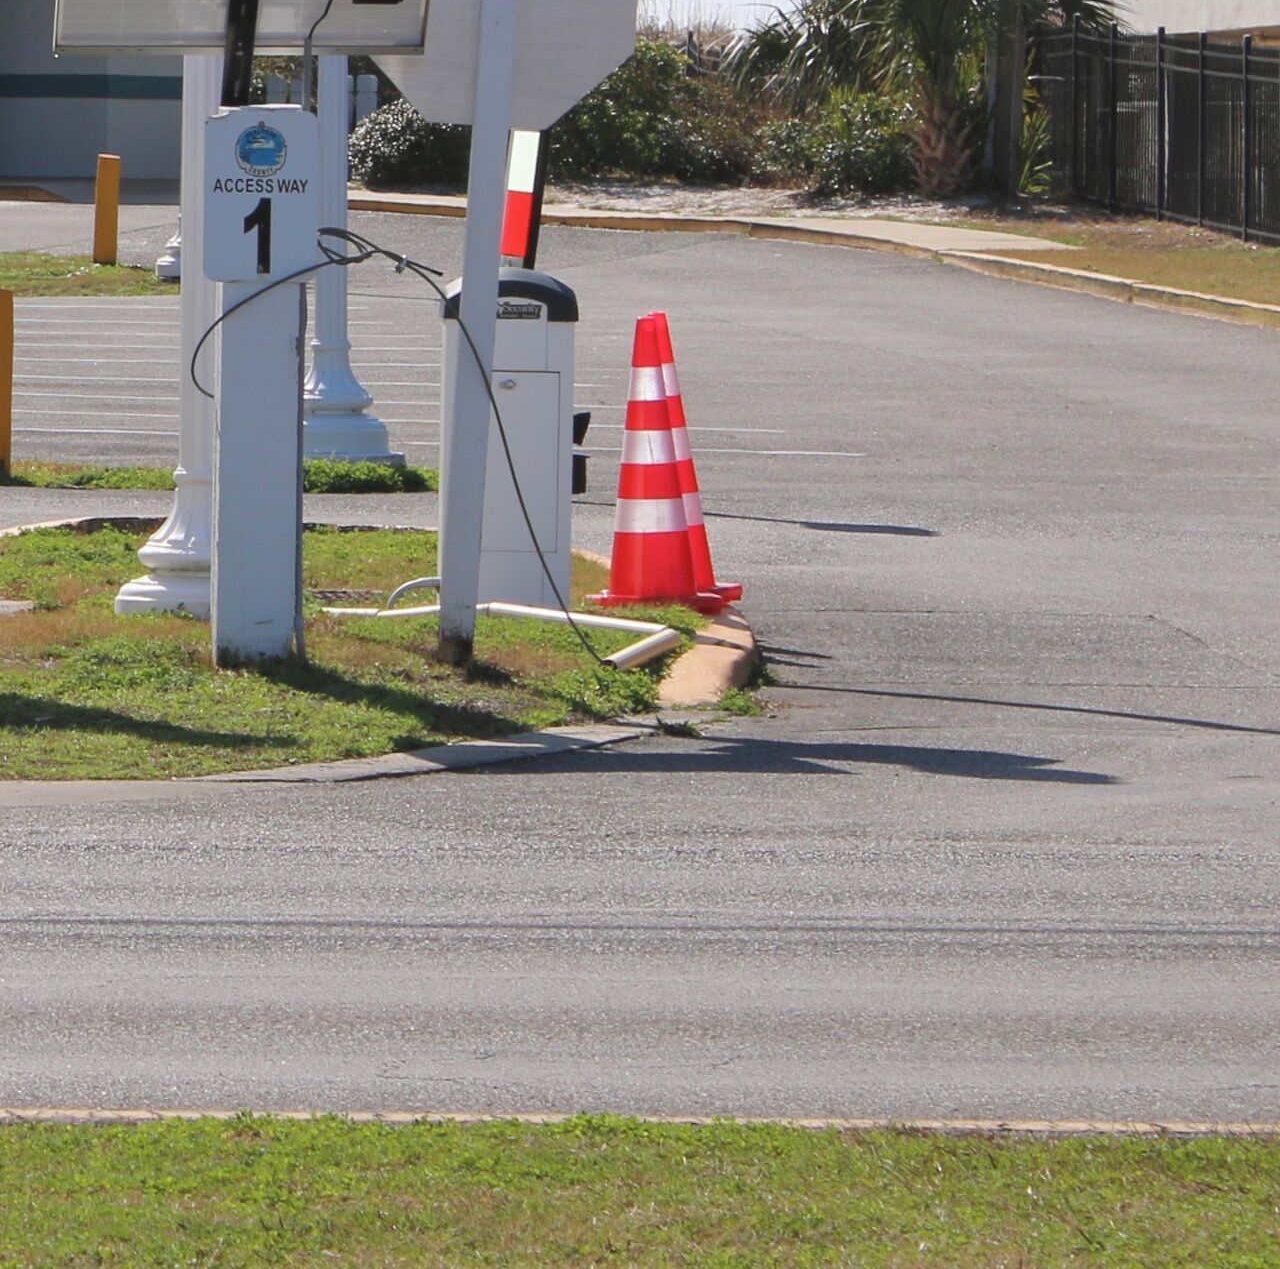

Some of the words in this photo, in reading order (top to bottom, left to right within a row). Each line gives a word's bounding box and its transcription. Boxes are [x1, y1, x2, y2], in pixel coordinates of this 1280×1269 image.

[213, 178, 274, 193] ACCESS
[277, 178, 309, 194] WAY
[243, 197, 272, 274] 1
